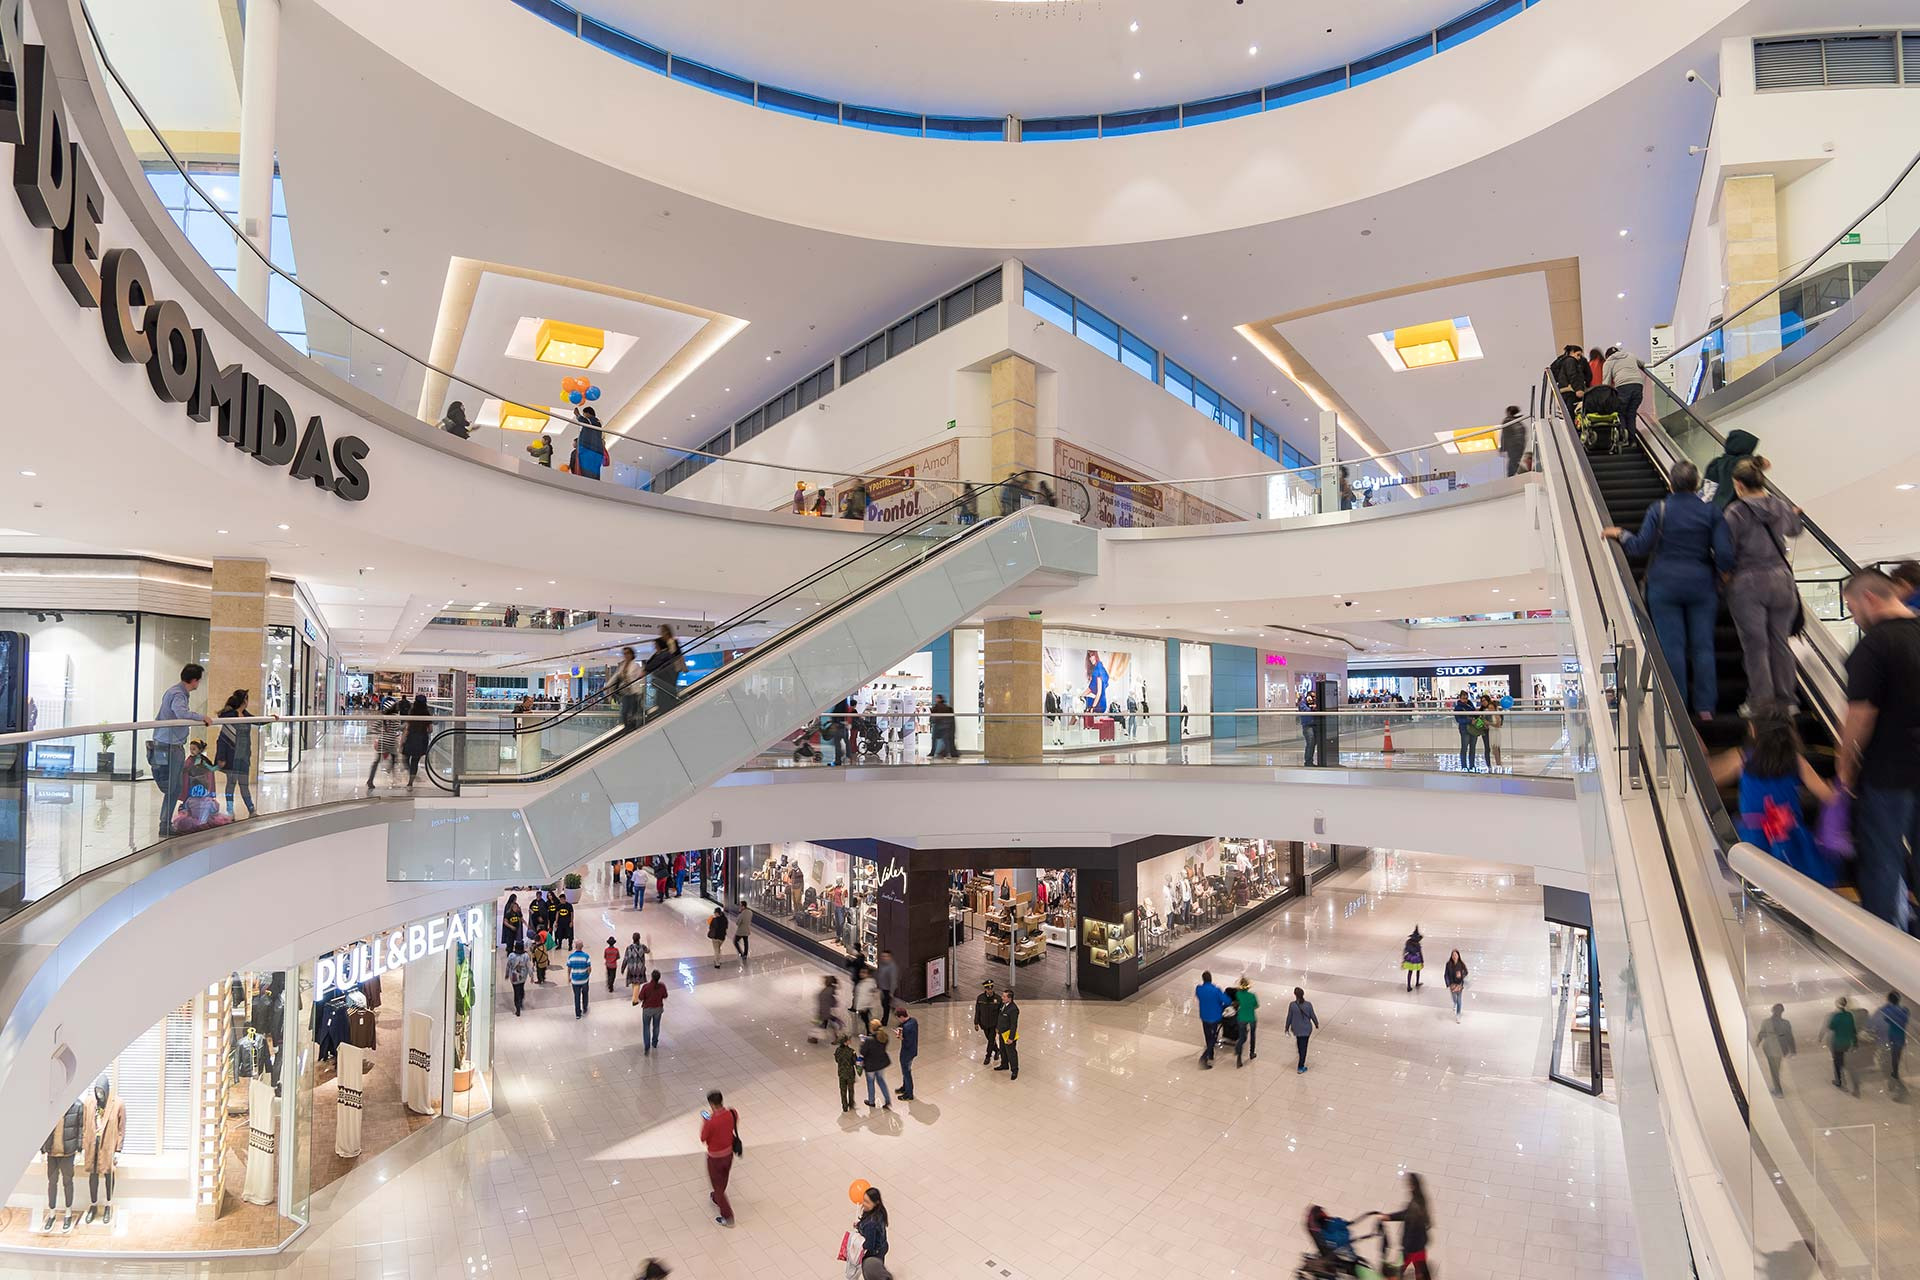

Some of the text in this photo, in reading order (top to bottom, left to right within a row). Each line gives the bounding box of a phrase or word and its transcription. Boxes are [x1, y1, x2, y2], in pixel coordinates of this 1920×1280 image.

[14, 45, 371, 503] DE COMIDAS
[1652, 336, 1659, 346] 3
[922, 454, 951, 473] Amor
[1436, 666, 1485, 676] STUDIO F
[314, 907, 485, 1003] PULL&BEAR
